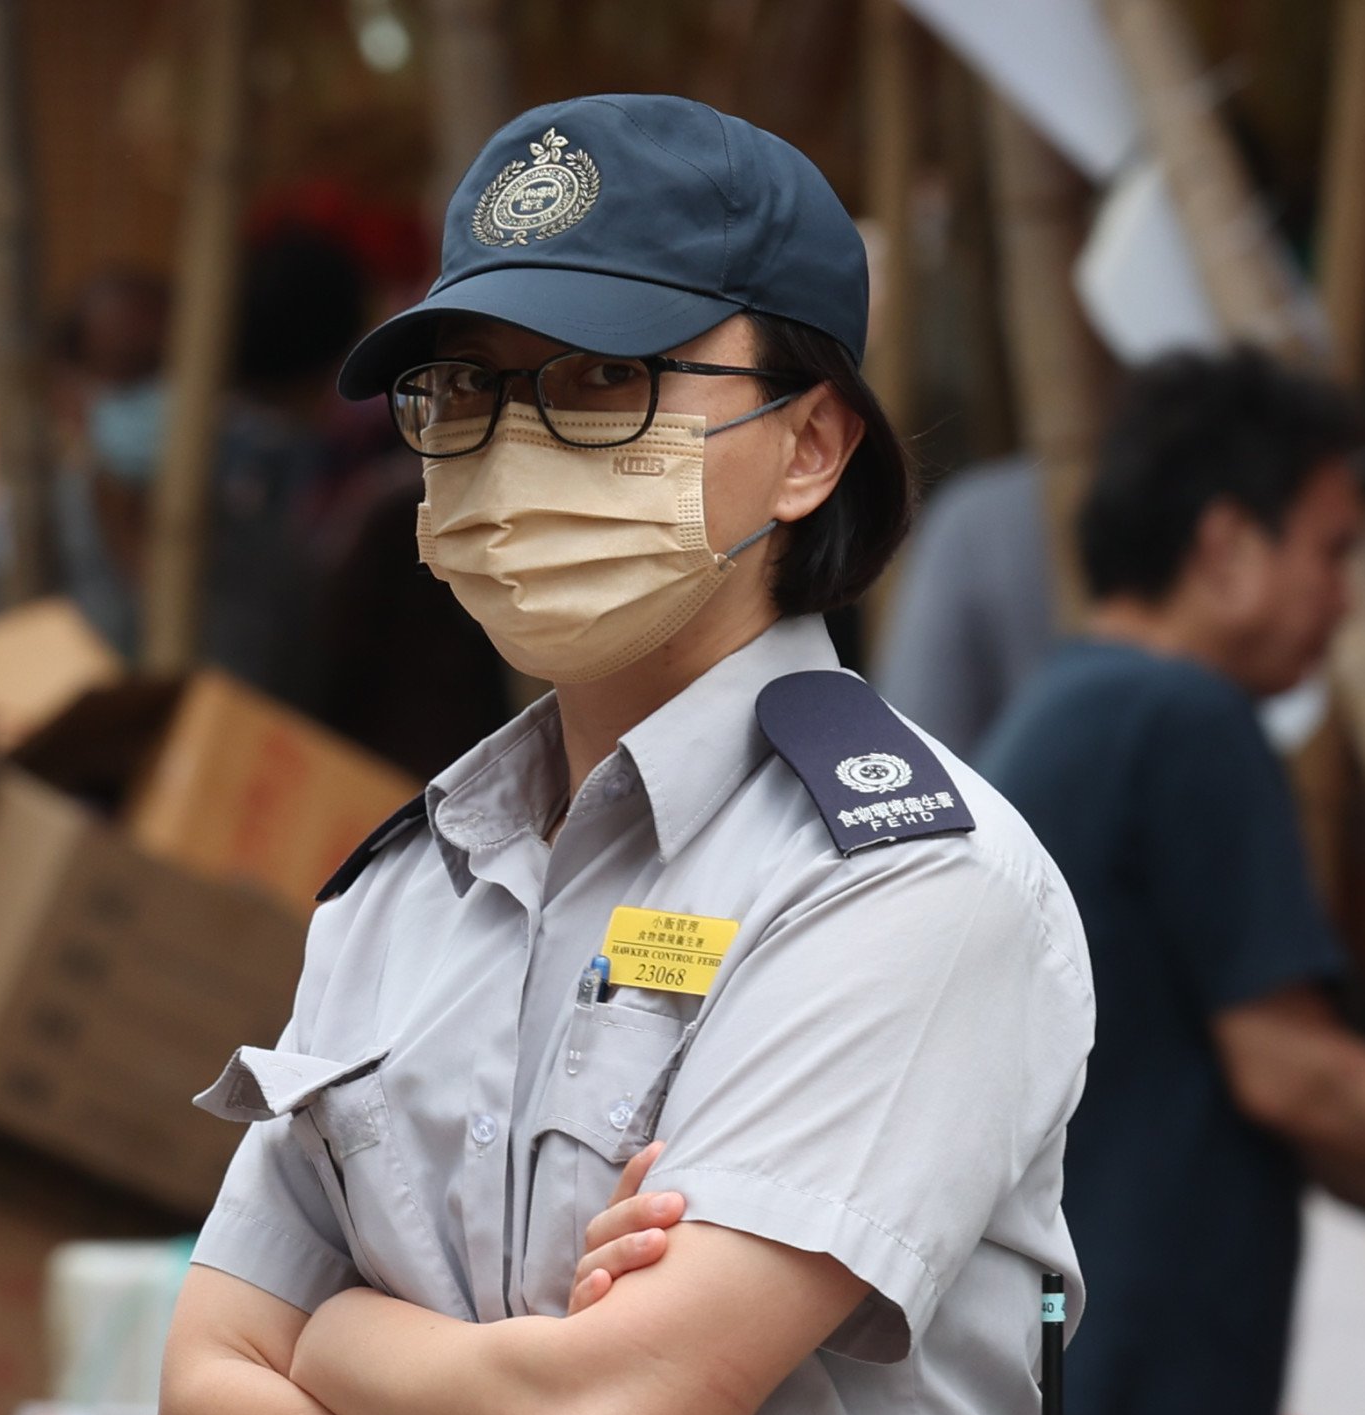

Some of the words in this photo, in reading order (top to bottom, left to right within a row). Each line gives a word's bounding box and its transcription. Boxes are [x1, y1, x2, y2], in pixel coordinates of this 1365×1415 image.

[870, 811, 934, 832] FEHD
[612, 945, 649, 958] HAWKER
[652, 951, 694, 964] CONTROL
[697, 957, 722, 967] FEHD
[635, 963, 686, 986] 23068
